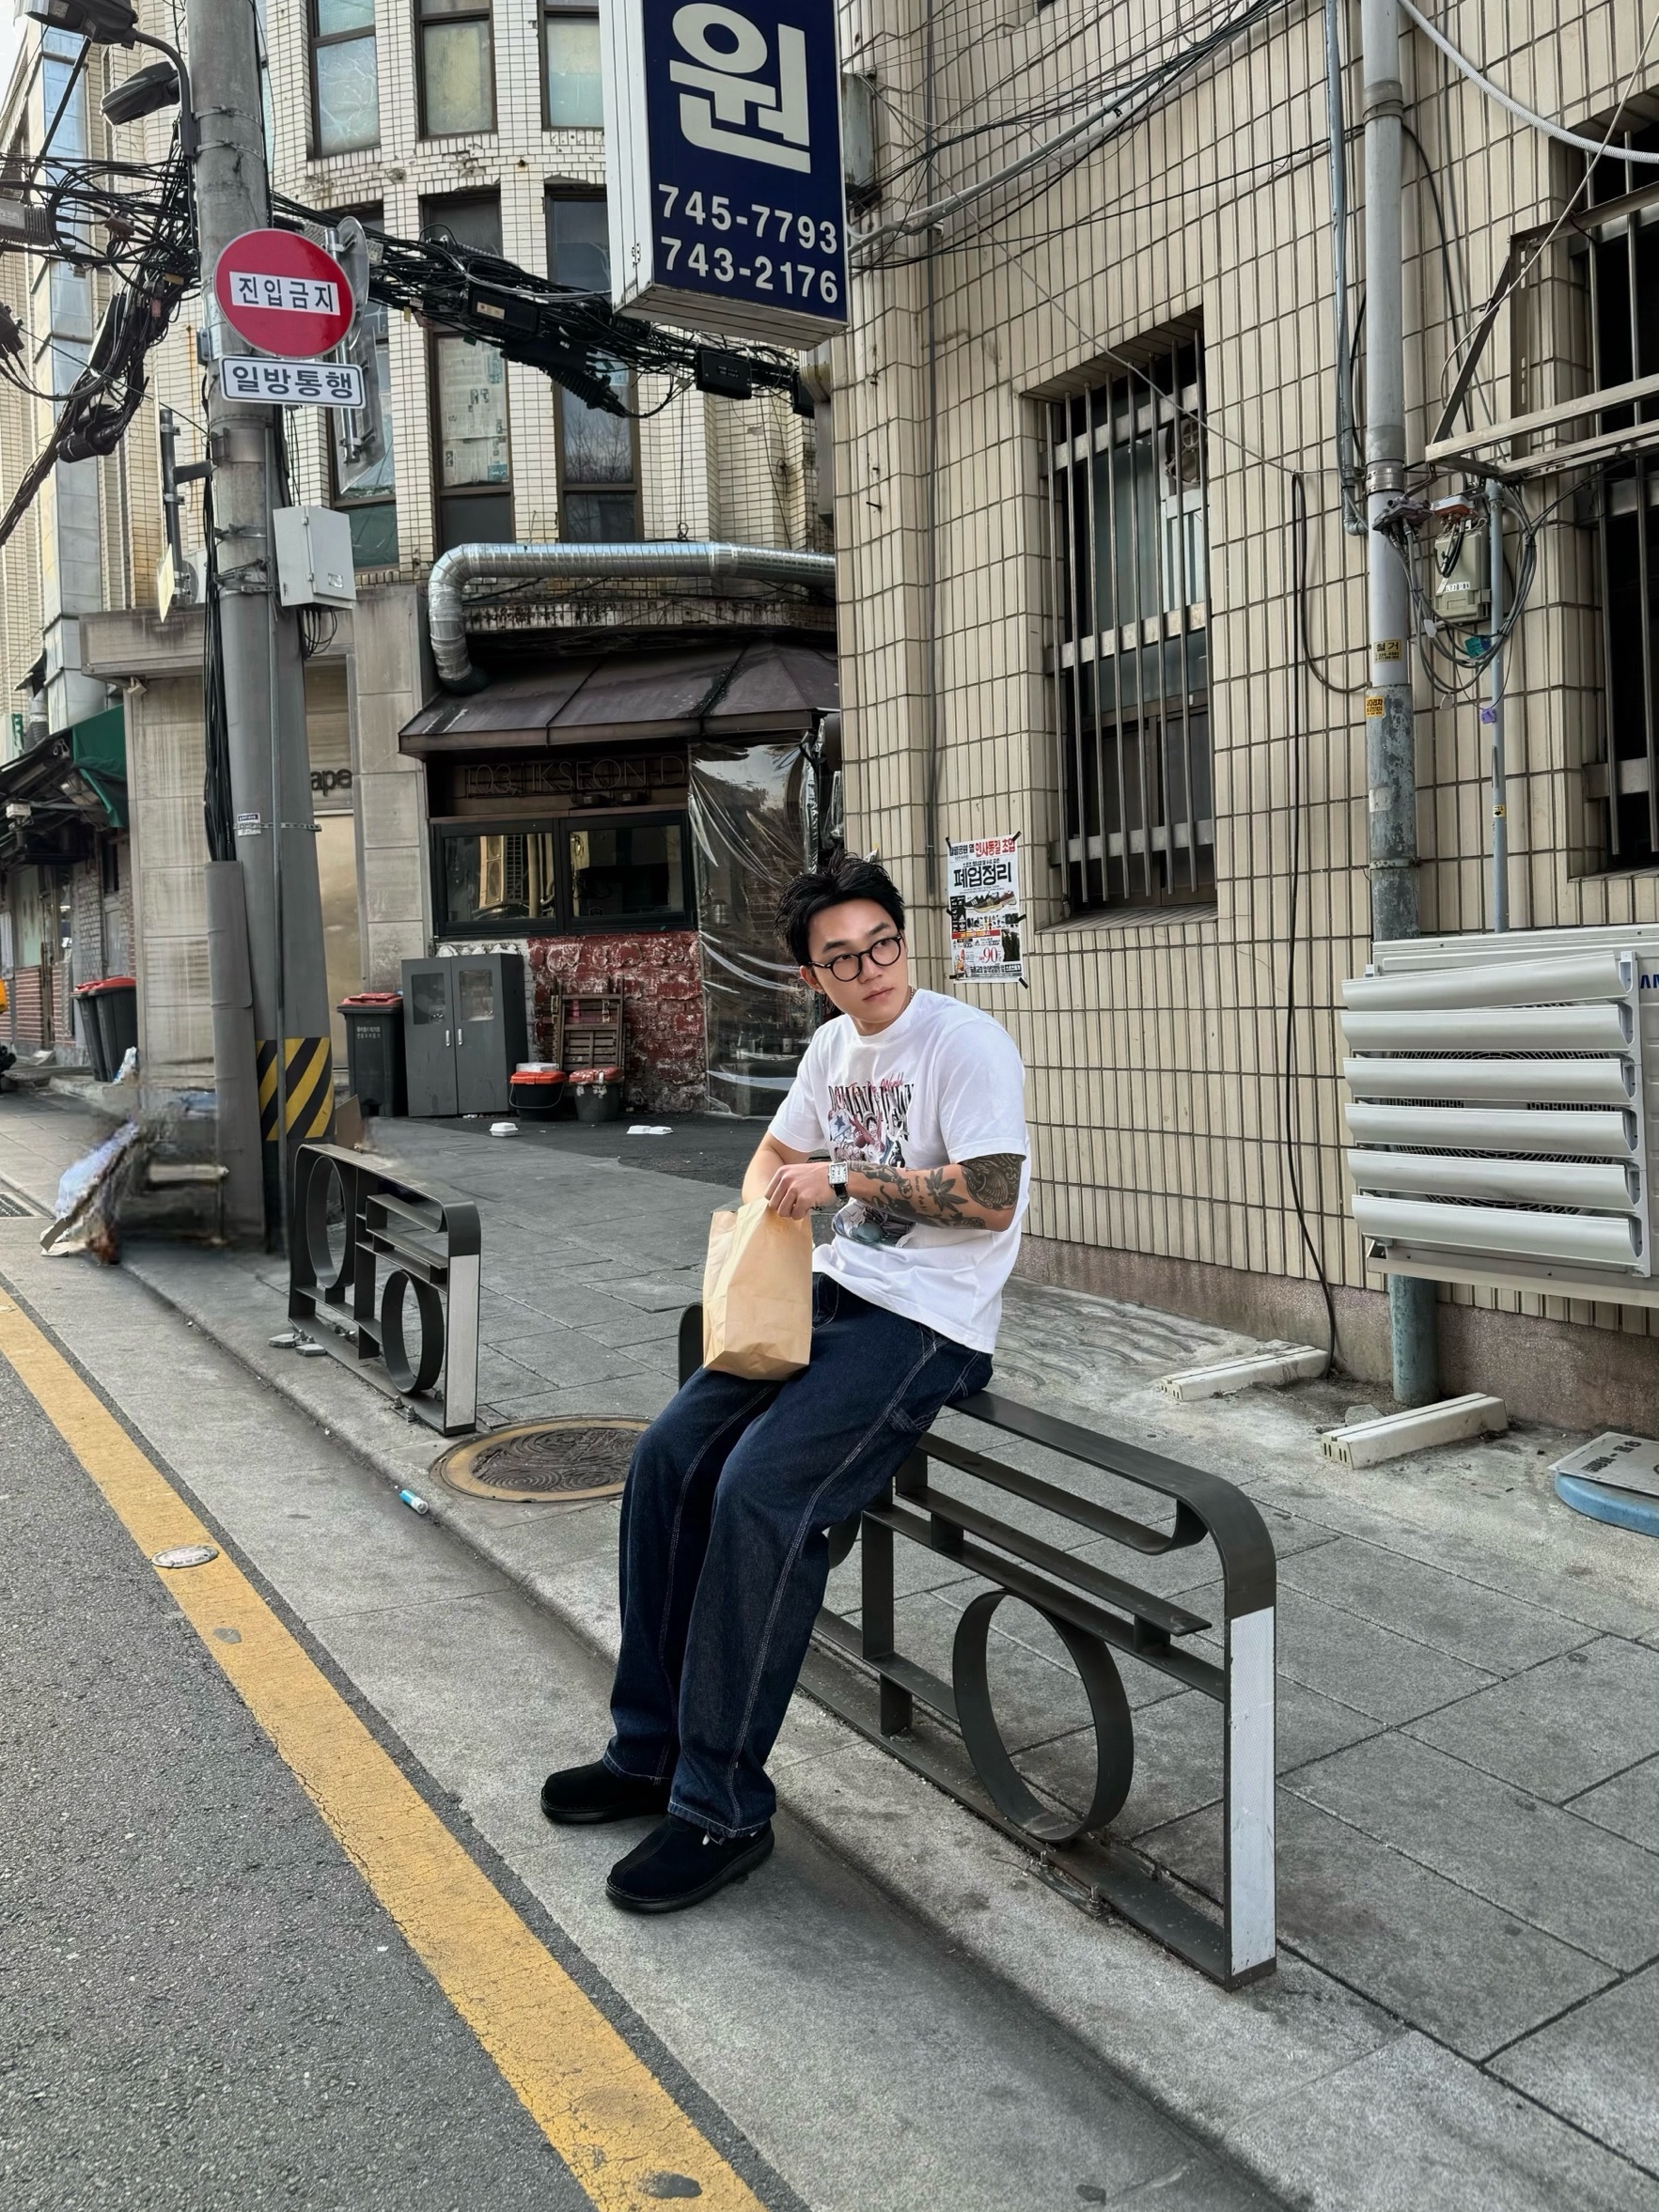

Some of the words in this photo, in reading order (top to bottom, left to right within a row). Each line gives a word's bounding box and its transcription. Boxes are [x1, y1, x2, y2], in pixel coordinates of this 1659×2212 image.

[669, 3, 811, 174] 원
[659, 184, 837, 254] 745-7793
[661, 236, 837, 304] 743-2176
[239, 276, 334, 312] 진입금지
[232, 366, 352, 398] 일방통행
[310, 769, 352, 797] ape
[954, 862, 1011, 888] 폐업정리
